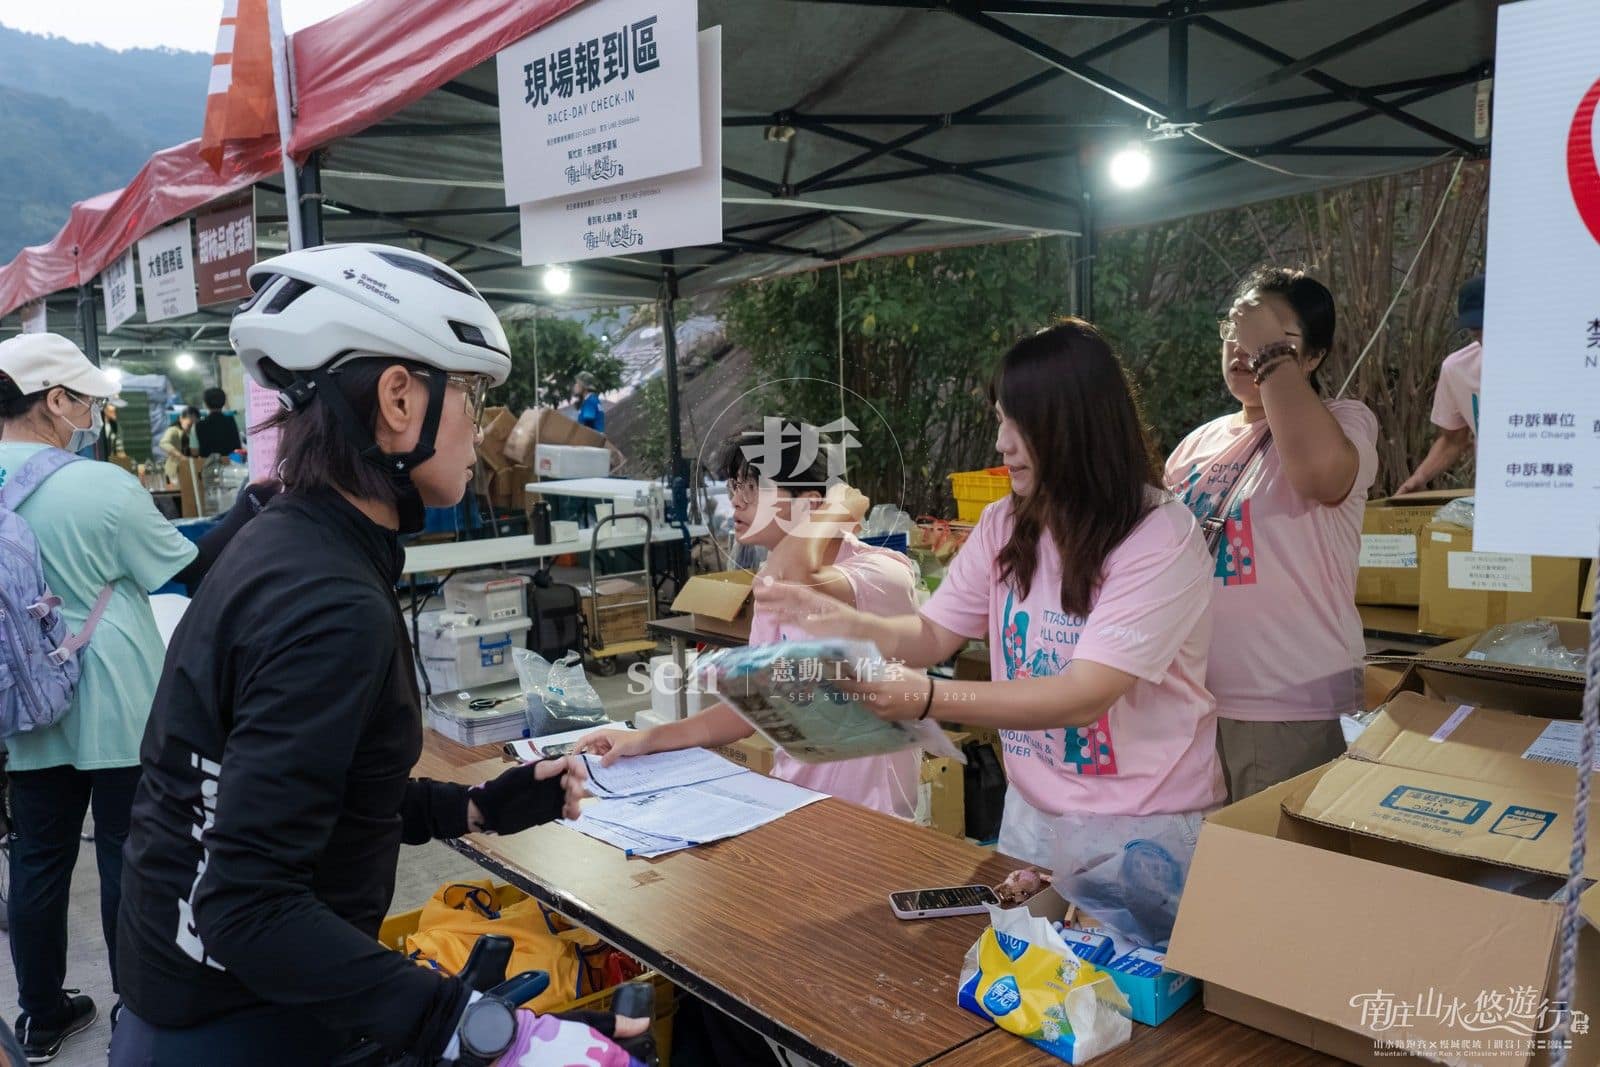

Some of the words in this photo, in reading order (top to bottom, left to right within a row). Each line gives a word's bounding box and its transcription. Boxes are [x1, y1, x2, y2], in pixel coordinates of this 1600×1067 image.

[523, 14, 661, 109] 現場報到區
[547, 104, 588, 126] RACE-DAY
[590, 88, 635, 113] CHECK-IN
[361, 273, 387, 289] Sweet
[358, 279, 400, 304] Protection
[1508, 413, 1575, 428] 申訴單位
[1507, 431, 1526, 439] Unit
[1529, 431, 1538, 439] in
[1540, 431, 1576, 440] Charge
[1506, 462, 1574, 477] 申訴專線
[1505, 480, 1551, 489] Complaint
[1554, 480, 1574, 488] Line
